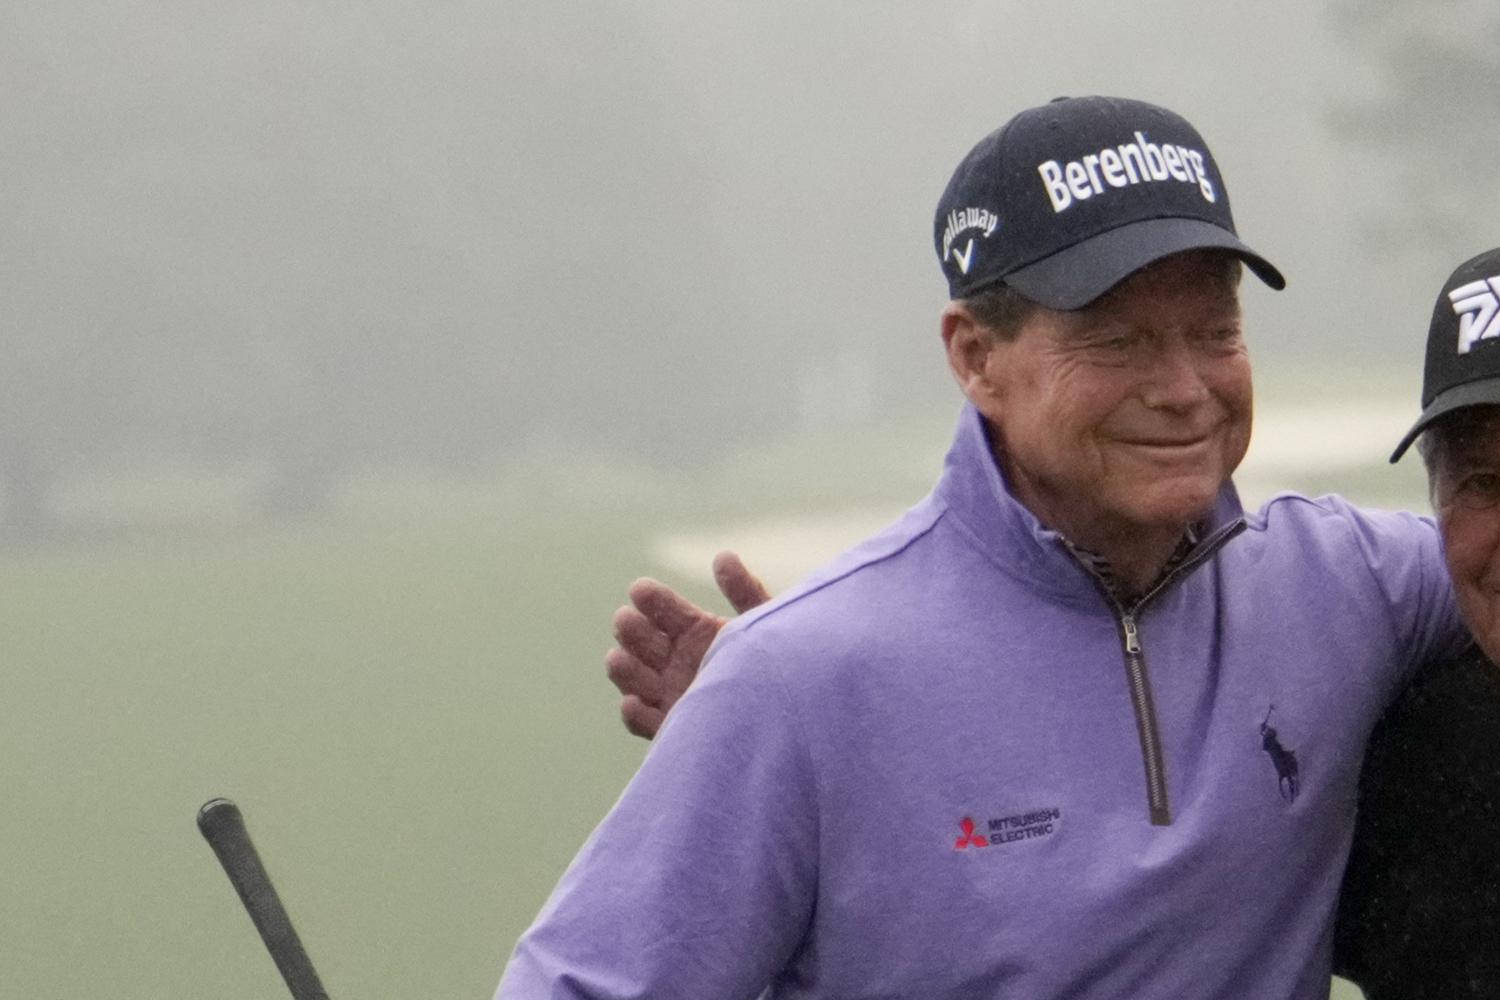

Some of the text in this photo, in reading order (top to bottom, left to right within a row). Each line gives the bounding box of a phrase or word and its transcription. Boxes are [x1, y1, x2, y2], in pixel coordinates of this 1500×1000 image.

[1038, 132, 1215, 213] Berenberg
[988, 808, 1060, 831] MITSUBISHI
[989, 824, 1054, 845] ELECTRIC
